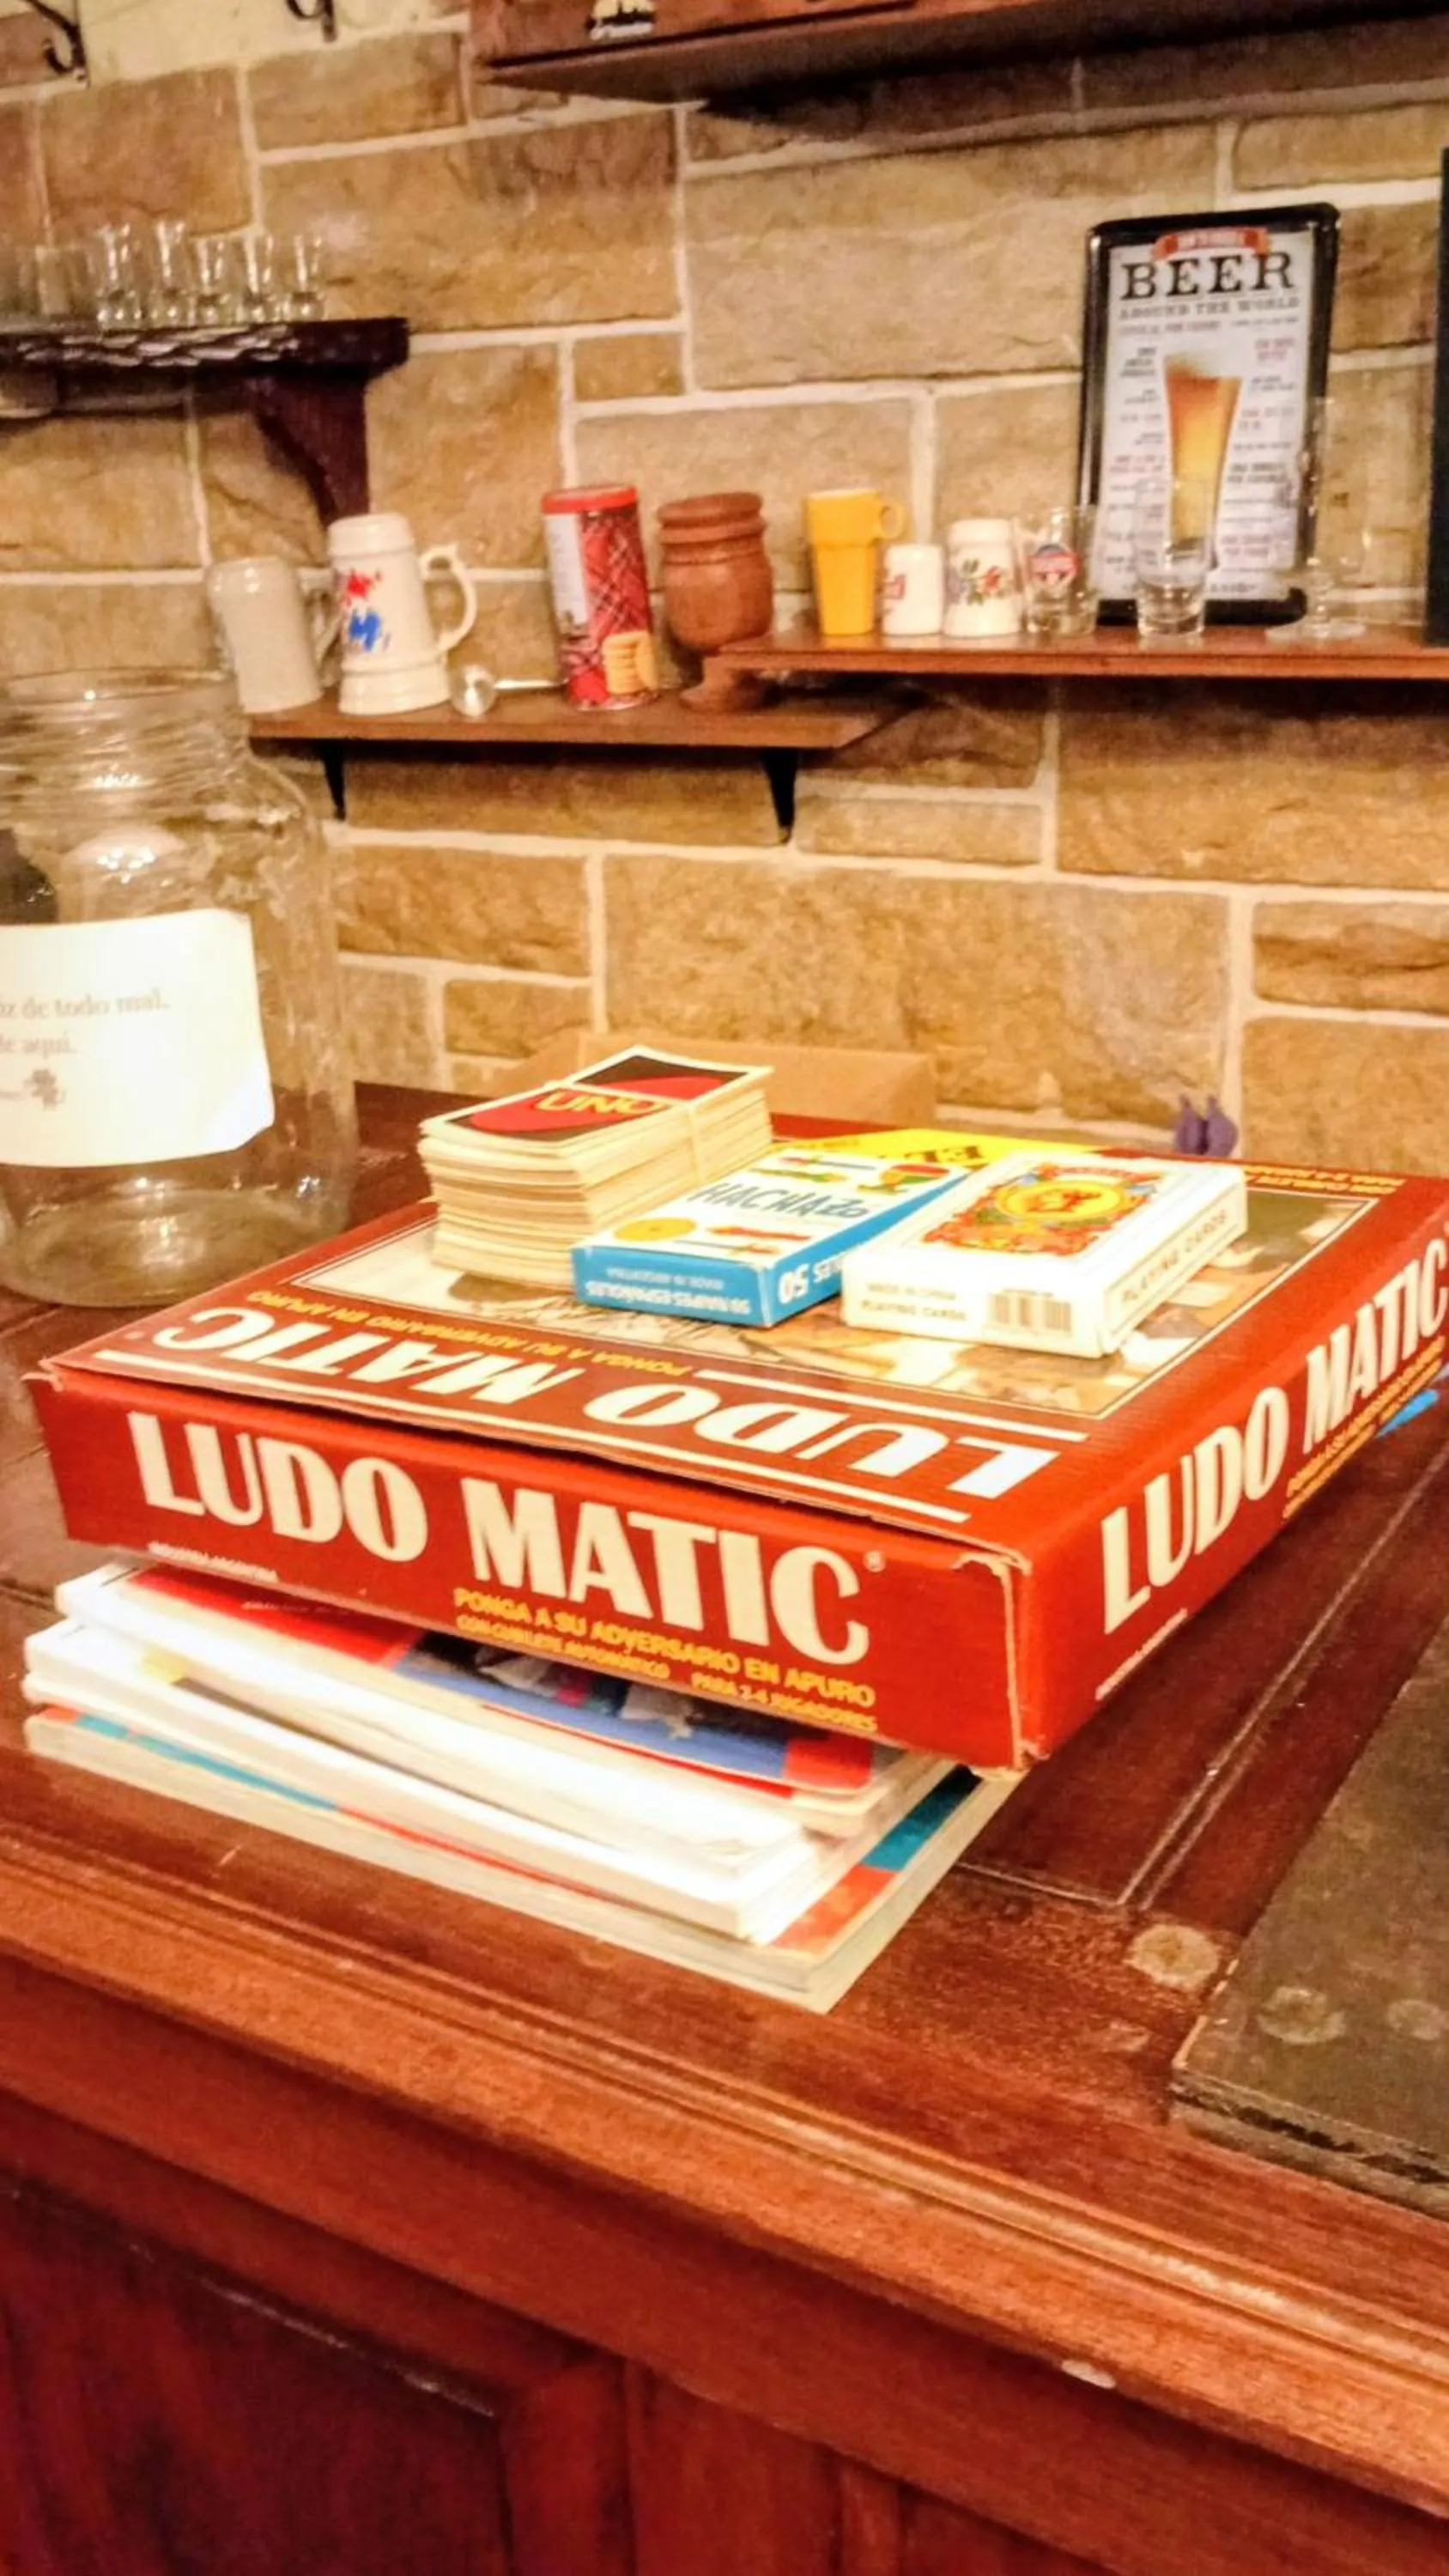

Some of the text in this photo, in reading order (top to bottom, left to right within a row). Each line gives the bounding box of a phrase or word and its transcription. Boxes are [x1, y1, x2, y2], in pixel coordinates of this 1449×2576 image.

[1120, 251, 1294, 301] BEER
[1119, 296, 1300, 320] AROUND THE WORLD
[22, 996, 49, 1019] de
[55, 993, 110, 1017] todo
[535, 1091, 670, 1115] UNO
[592, 1351, 693, 1376] PONGA
[152, 1307, 1061, 1499] LUDO MATIC
[1101, 1387, 1288, 1634] LUDO
[1303, 1237, 1449, 1455] MATIC
[127, 1411, 870, 1666] LUDO MATIC
[453, 1587, 876, 1708] PONGA A SU ADVERSARIO EN APURO
